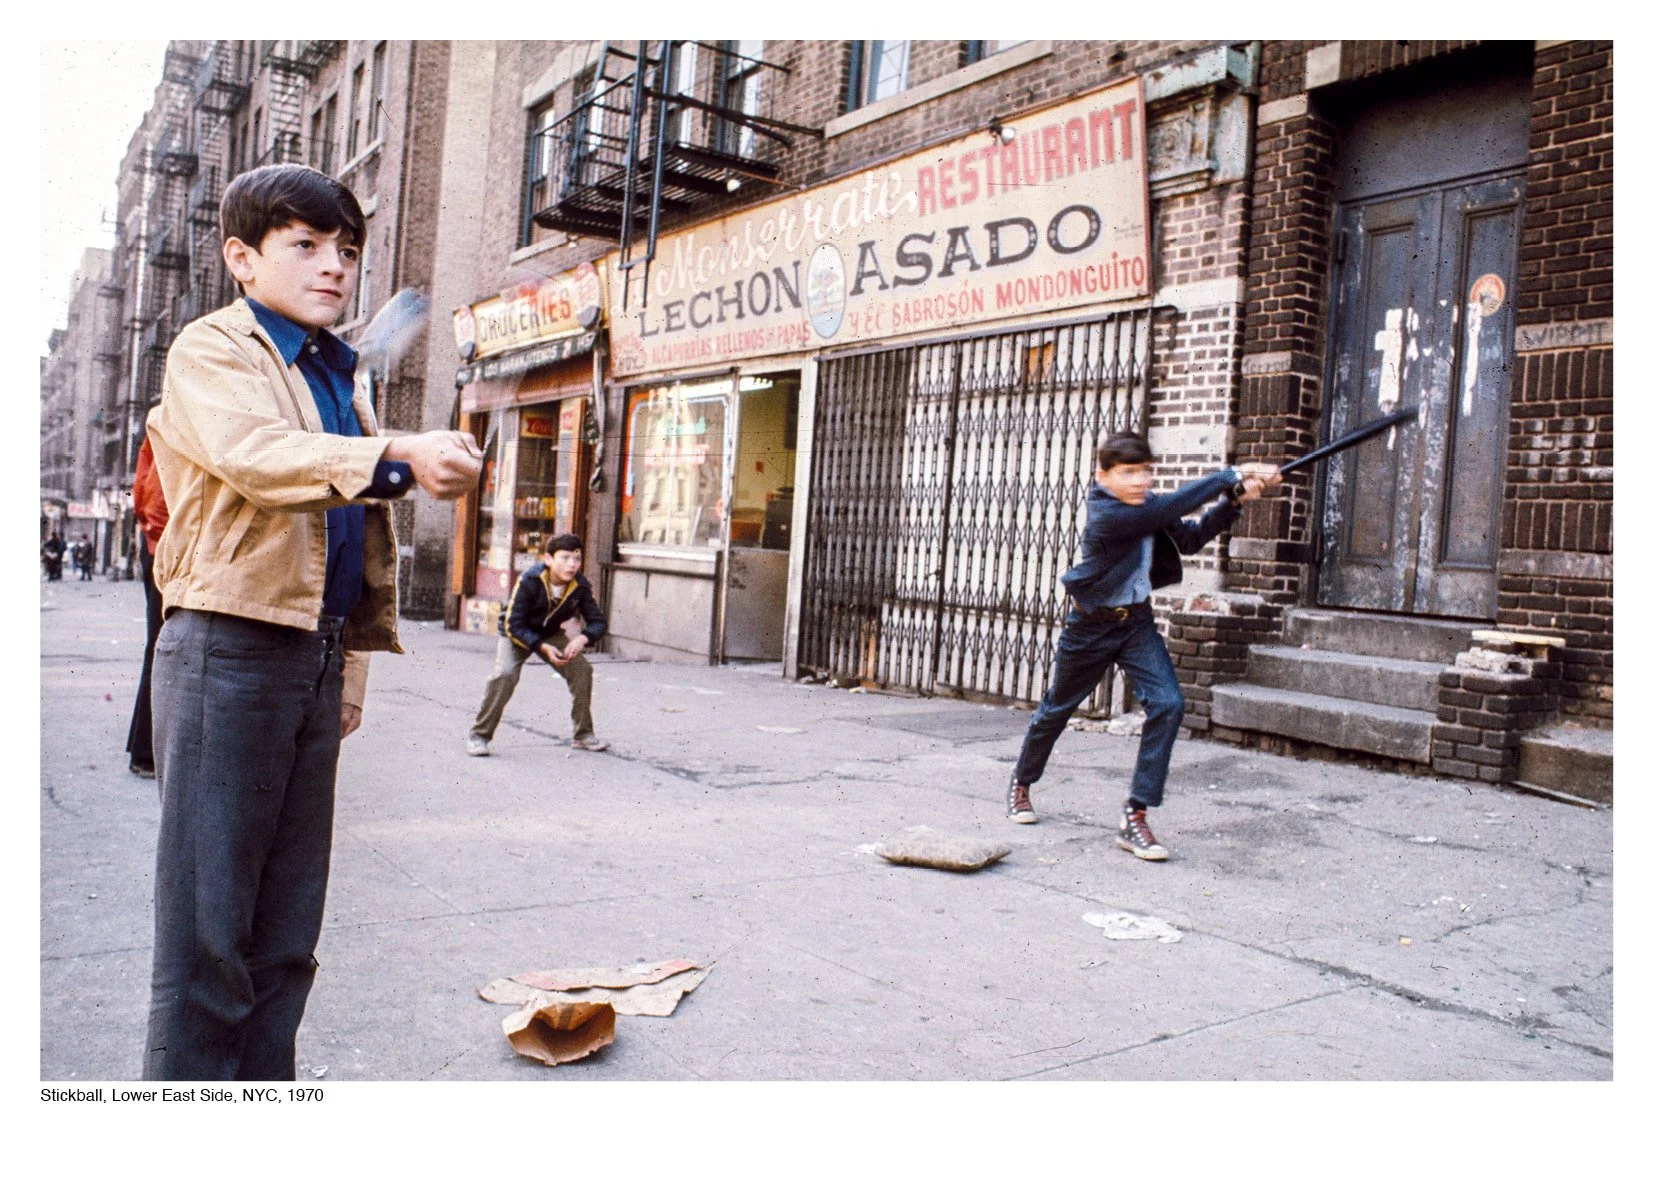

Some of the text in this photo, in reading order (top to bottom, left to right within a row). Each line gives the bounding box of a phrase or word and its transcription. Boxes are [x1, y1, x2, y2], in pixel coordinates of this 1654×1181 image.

[918, 98, 1137, 217] RESTAURANT
[639, 260, 801, 338] LECHON
[850, 205, 1102, 296] ASADO
